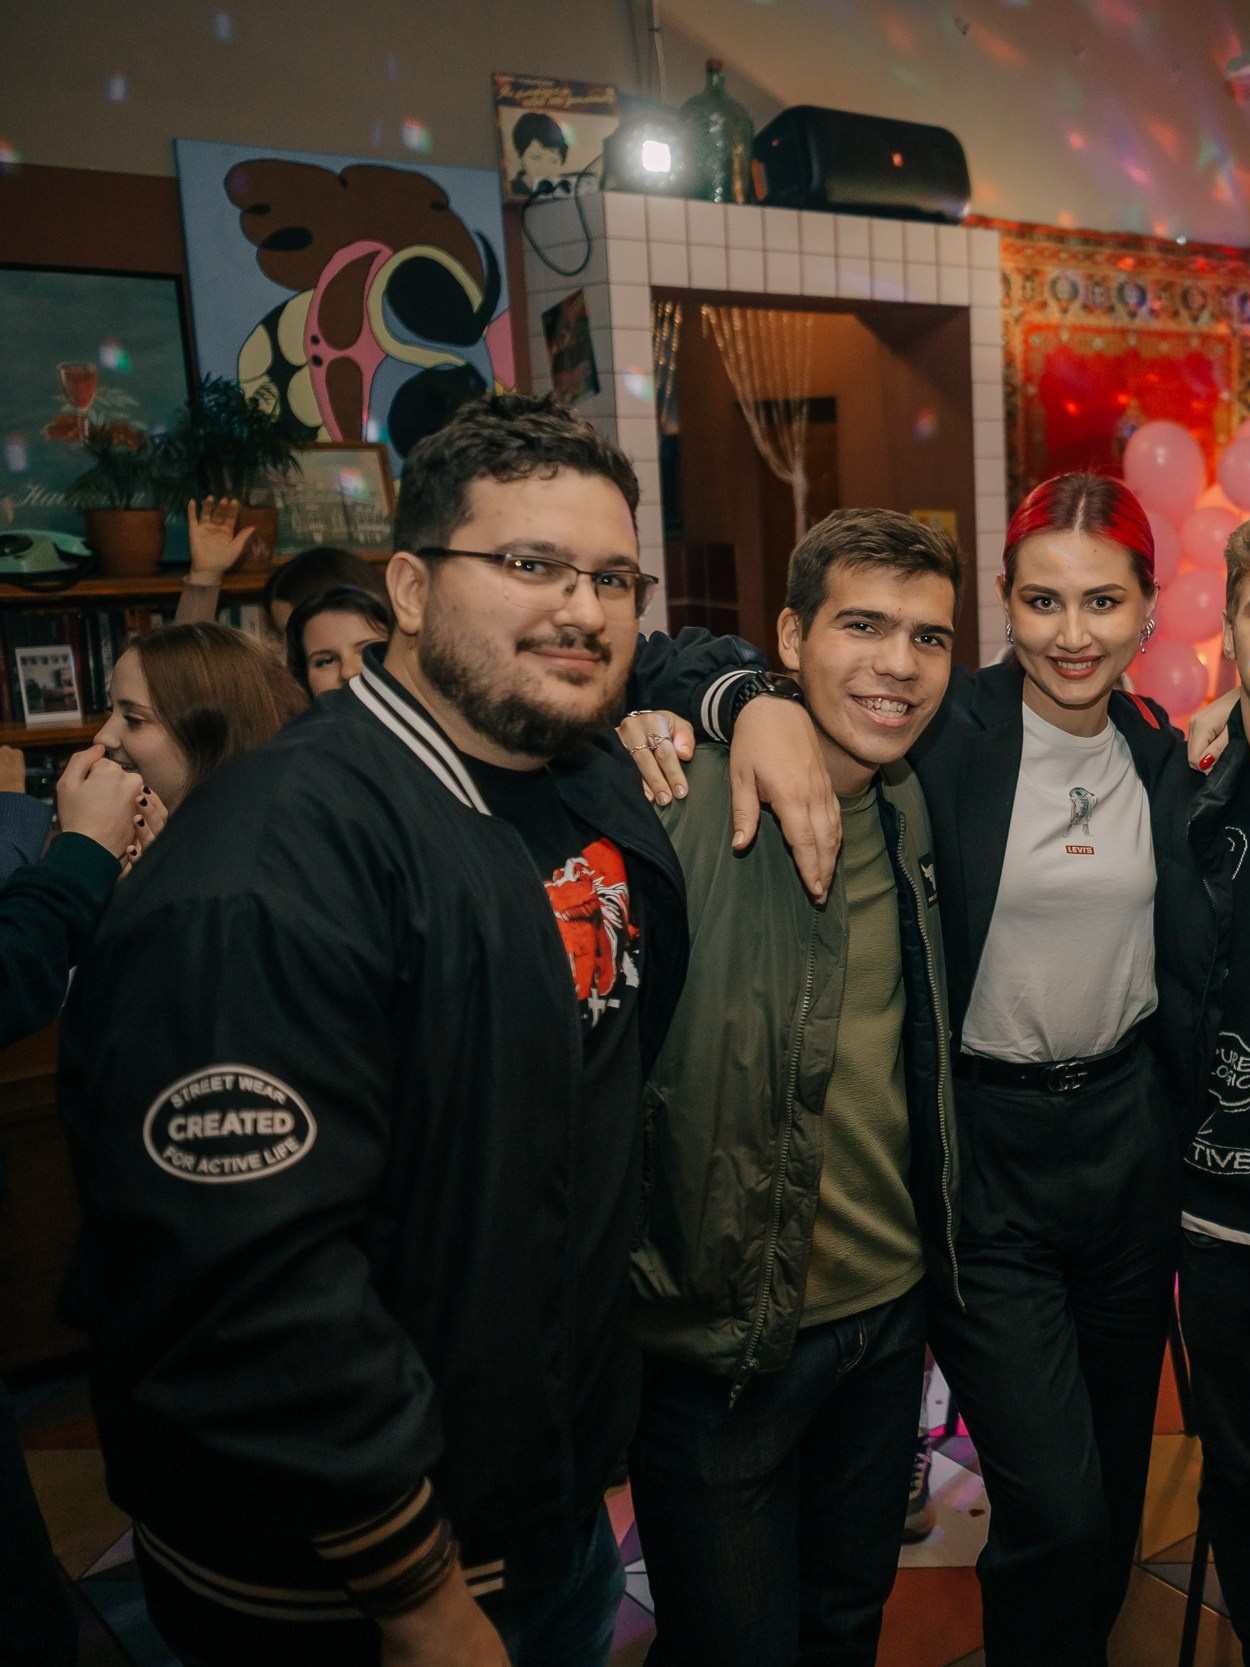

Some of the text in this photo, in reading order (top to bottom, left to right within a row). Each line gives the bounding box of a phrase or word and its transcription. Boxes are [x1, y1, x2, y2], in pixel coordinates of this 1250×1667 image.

[170, 1074, 287, 1109] STREET WEAR
[168, 1109, 296, 1142] CREATED
[162, 1136, 301, 1175] FOR ACTIVE LIFE
